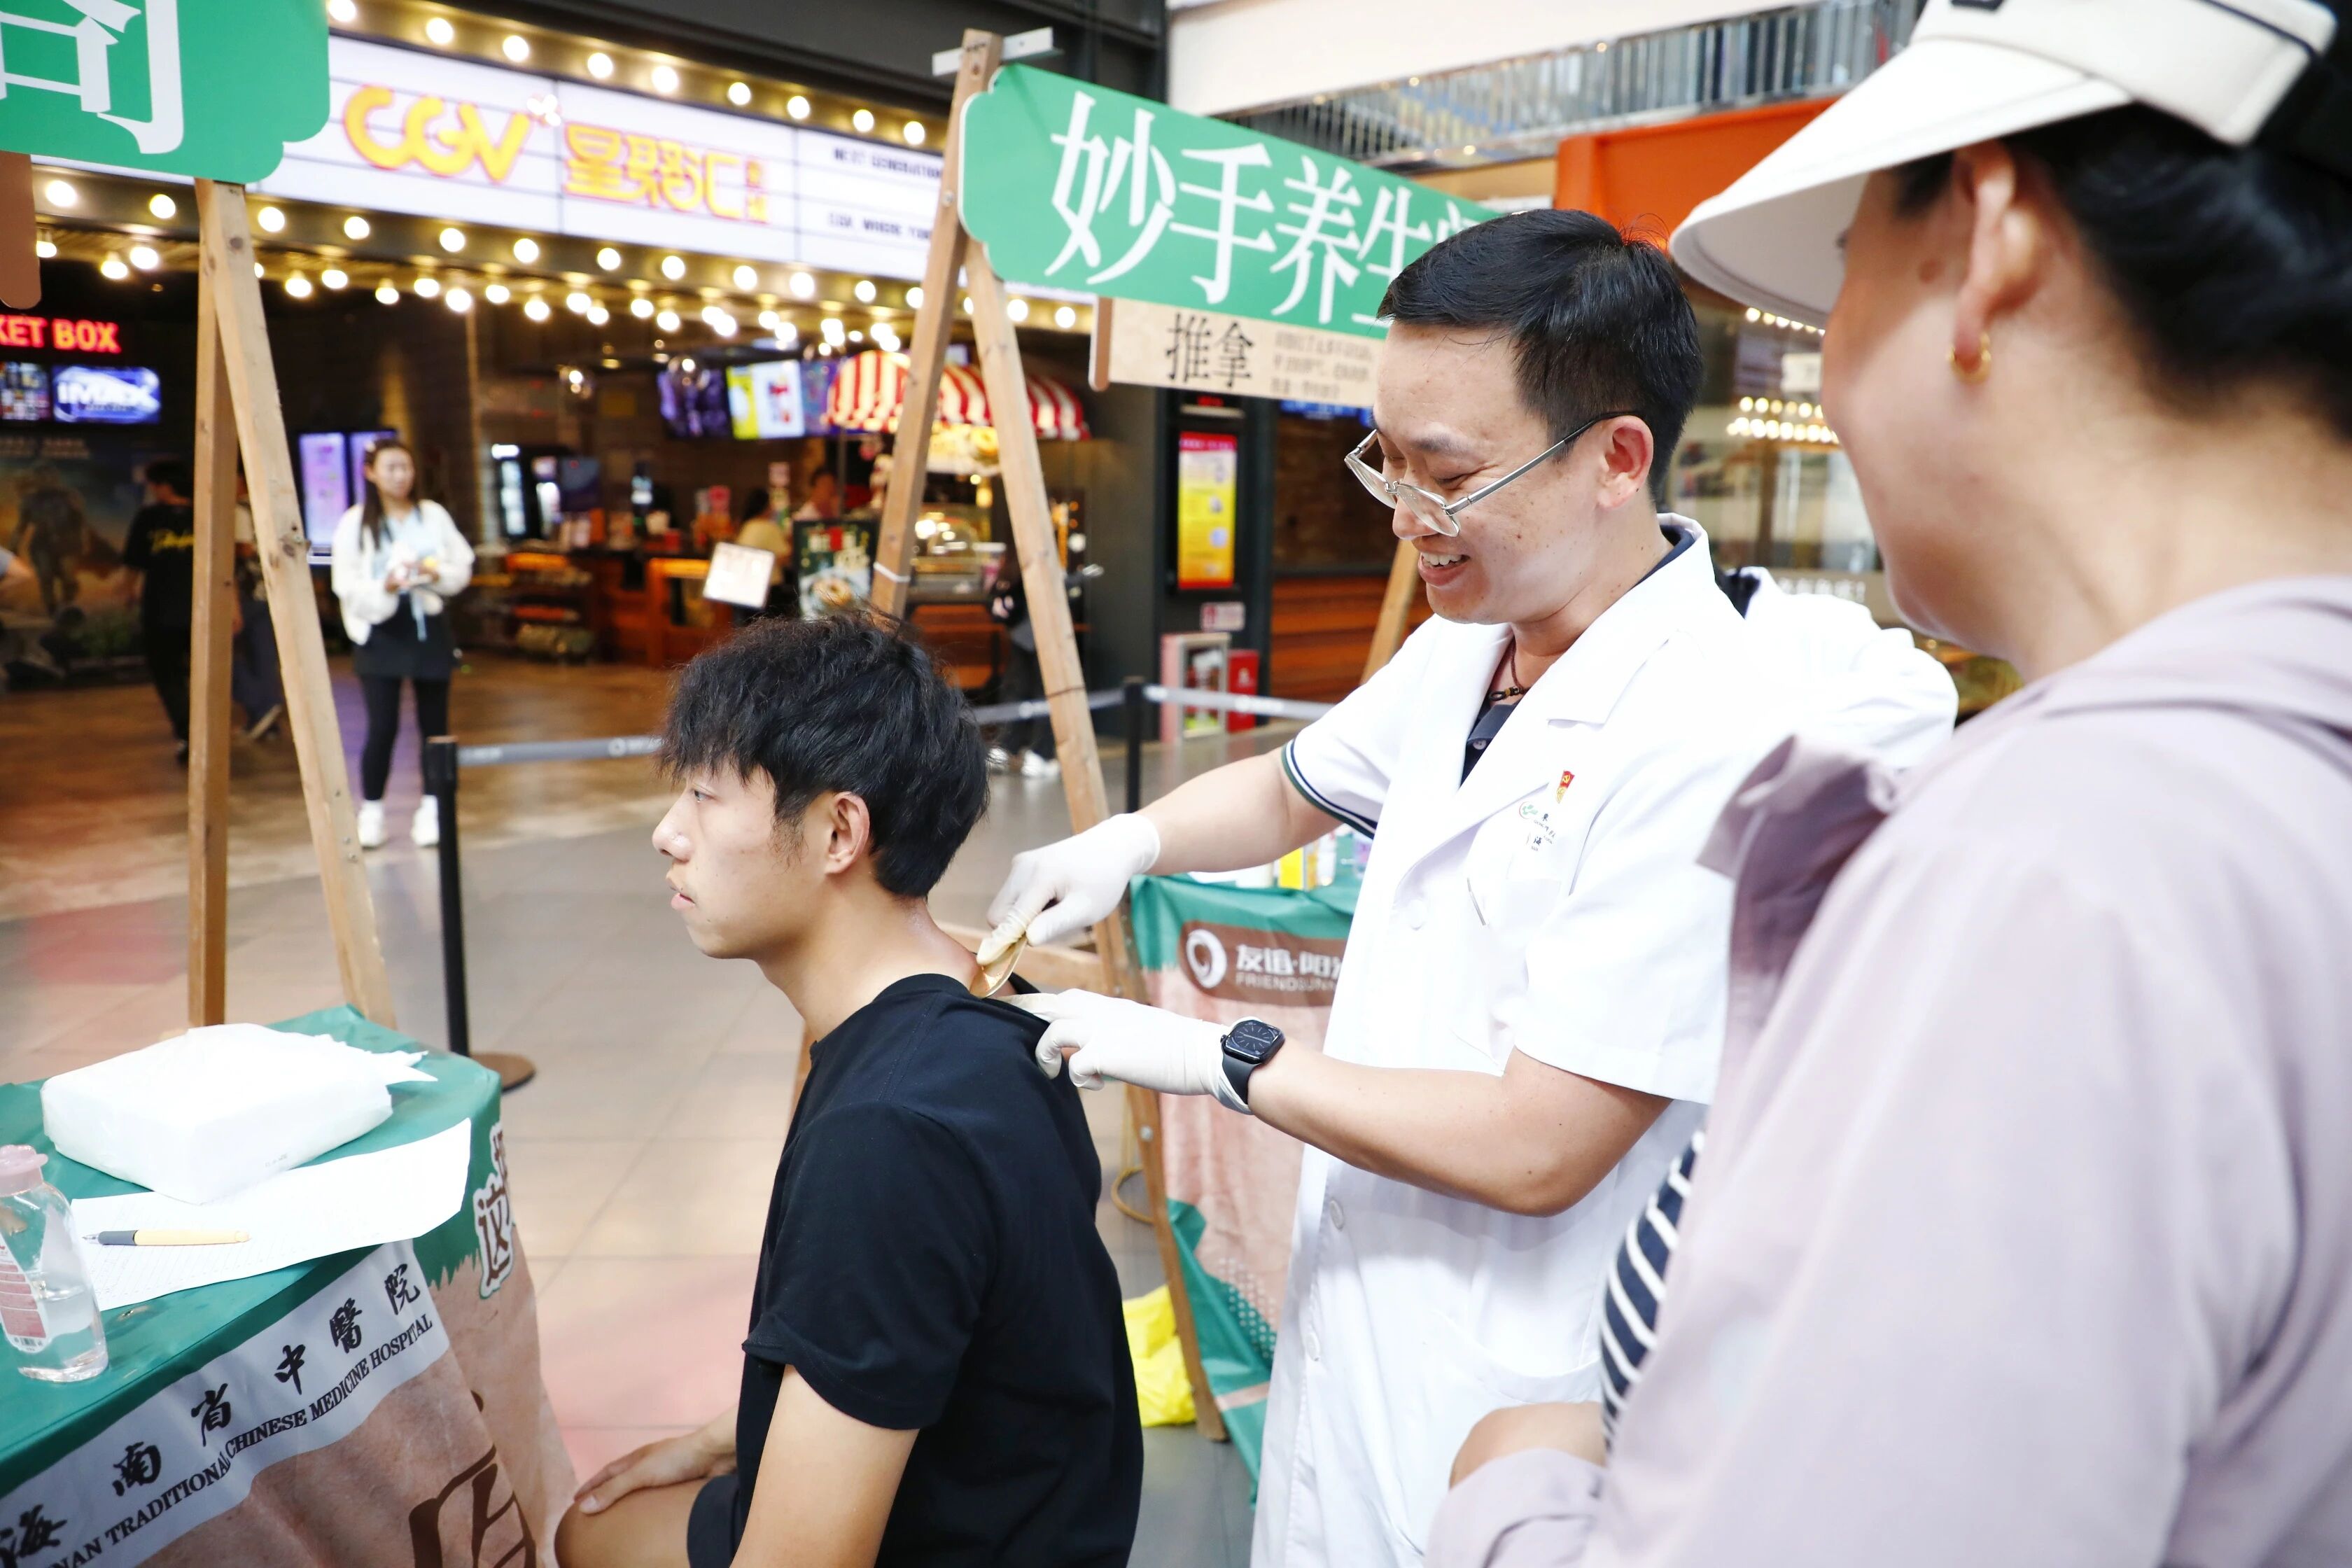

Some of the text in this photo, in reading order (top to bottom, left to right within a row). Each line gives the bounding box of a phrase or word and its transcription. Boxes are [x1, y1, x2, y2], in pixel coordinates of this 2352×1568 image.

[342, 85, 531, 184] CGV
[1044, 90, 1481, 327] 妙手养生
[52, 317, 121, 354] BOX
[1166, 312, 1254, 387] 推拿
[105, 1452, 232, 1546] TRADITIONAL
[225, 1408, 307, 1459] CHINESE
[309, 1355, 370, 1422] MEDICINE
[369, 1313, 433, 1370] HOSPITAL
